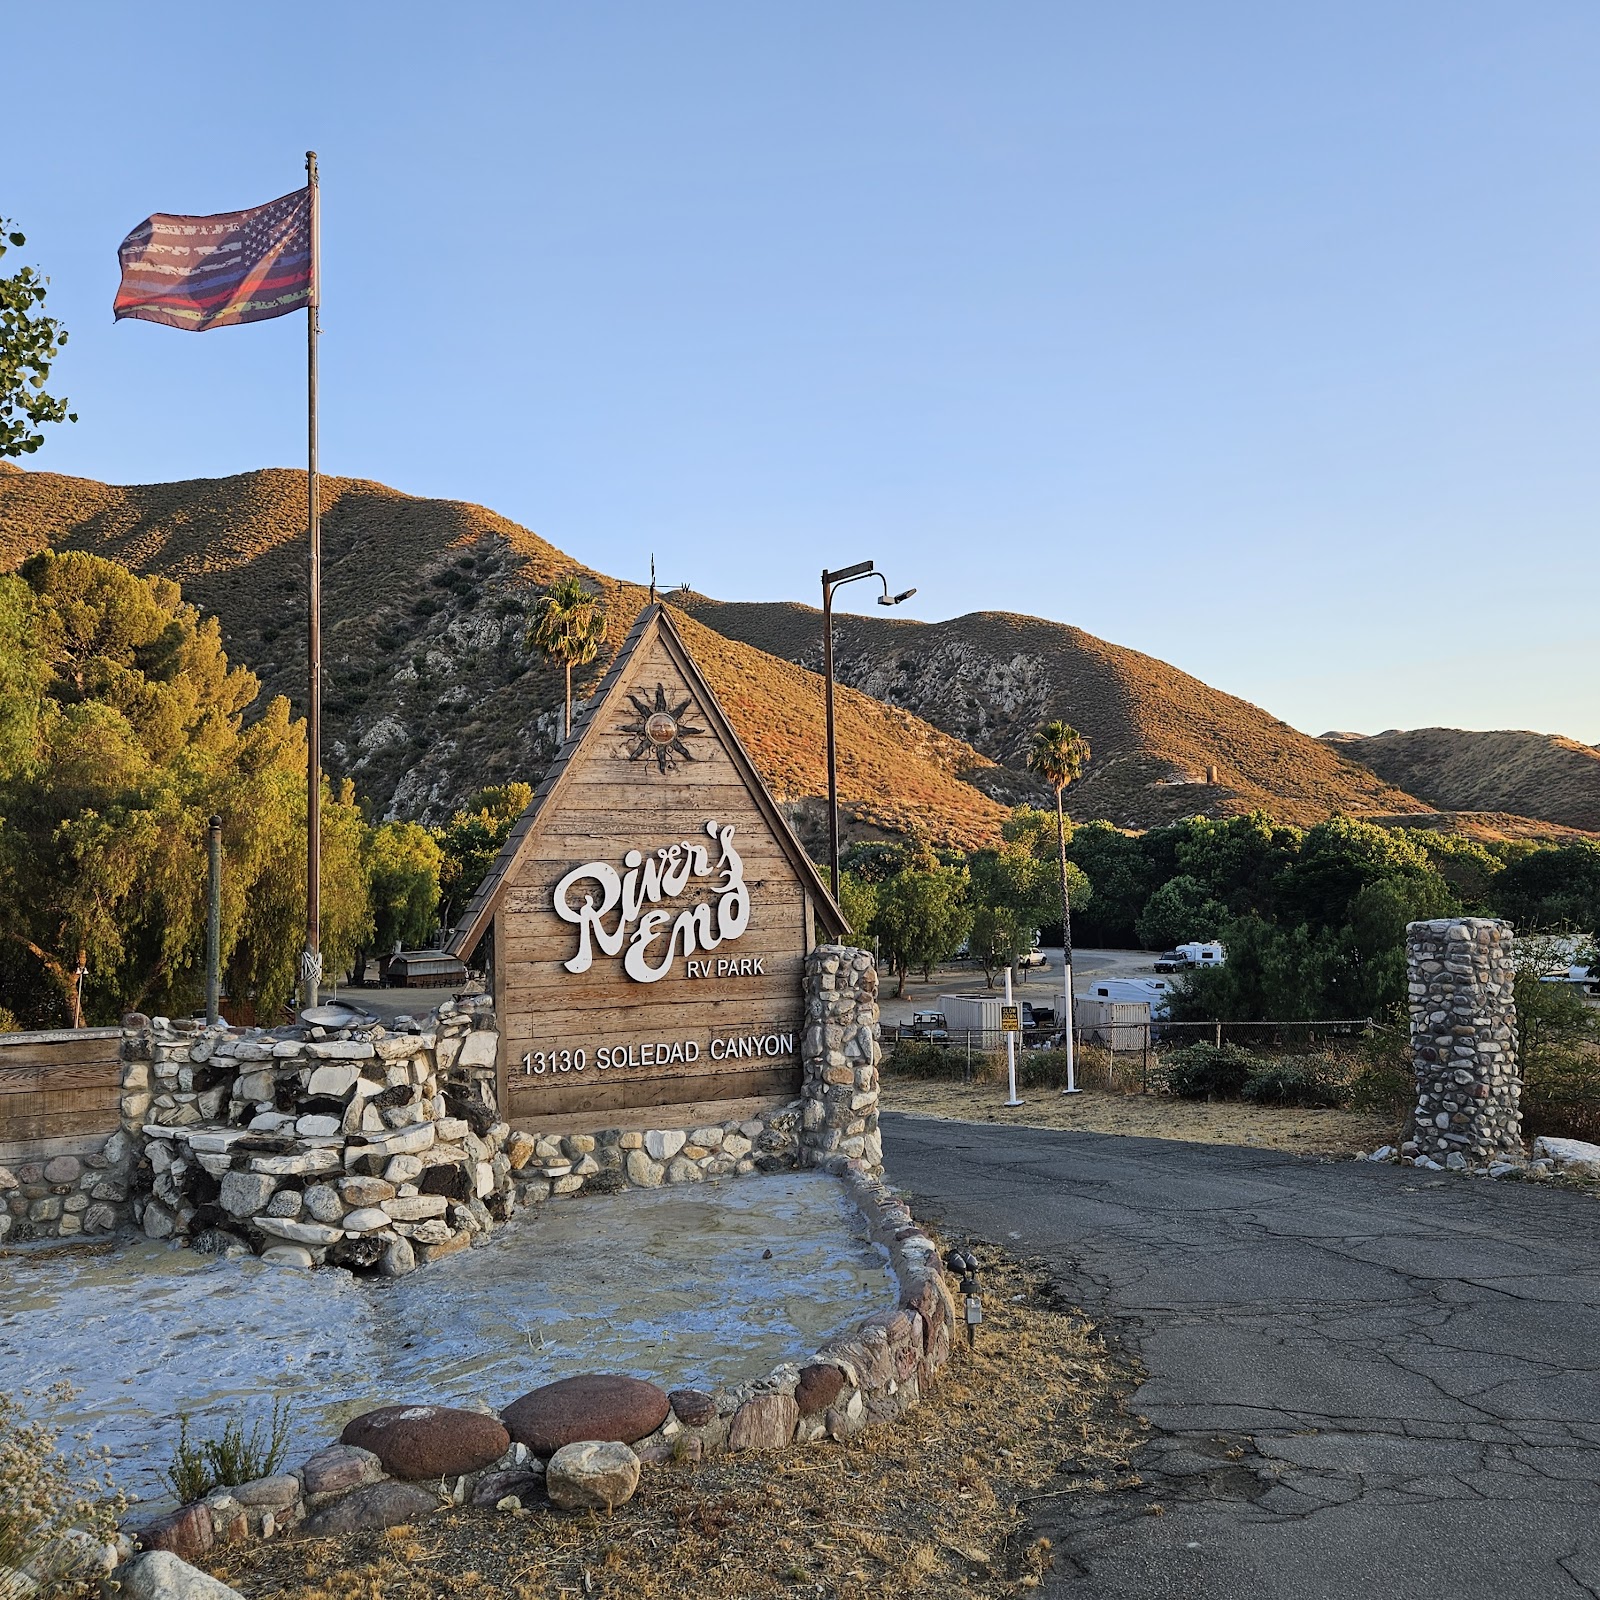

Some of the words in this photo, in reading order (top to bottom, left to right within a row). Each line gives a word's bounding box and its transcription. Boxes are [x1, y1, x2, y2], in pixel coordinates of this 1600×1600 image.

[687, 960, 712, 978] RV
[717, 958, 765, 977] PARK
[522, 1047, 586, 1075] 13130
[596, 1040, 699, 1069] SOLEDAD
[710, 1033, 794, 1061] CANYON
